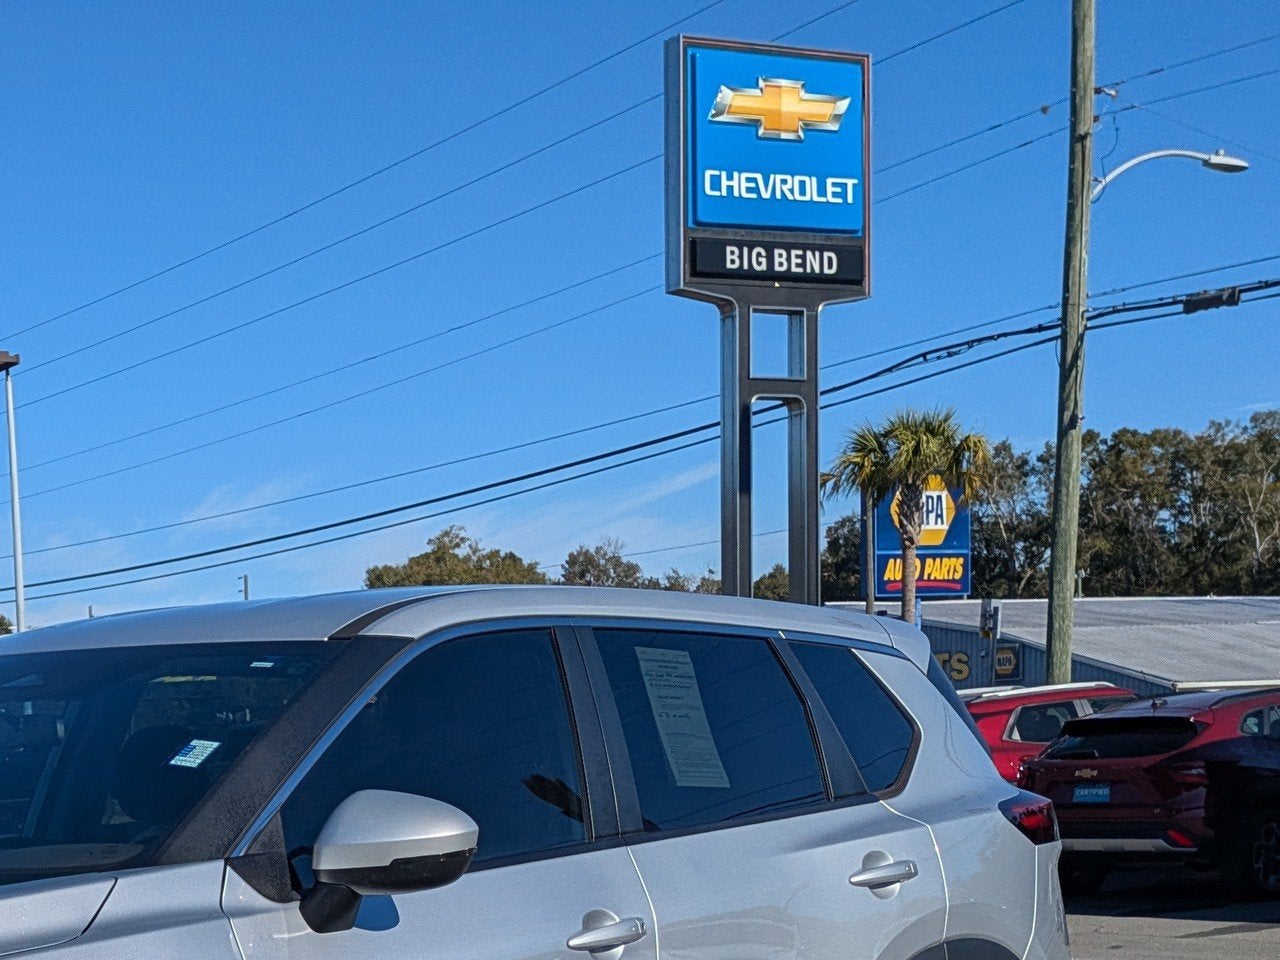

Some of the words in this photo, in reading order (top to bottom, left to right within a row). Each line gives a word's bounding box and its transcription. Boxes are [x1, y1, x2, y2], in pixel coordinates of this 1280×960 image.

[704, 169, 859, 204] CHEVROLET
[725, 245, 767, 272] BIG
[774, 248, 838, 275] BEND
[883, 558, 922, 581] AUO
[923, 557, 964, 580] PARTS
